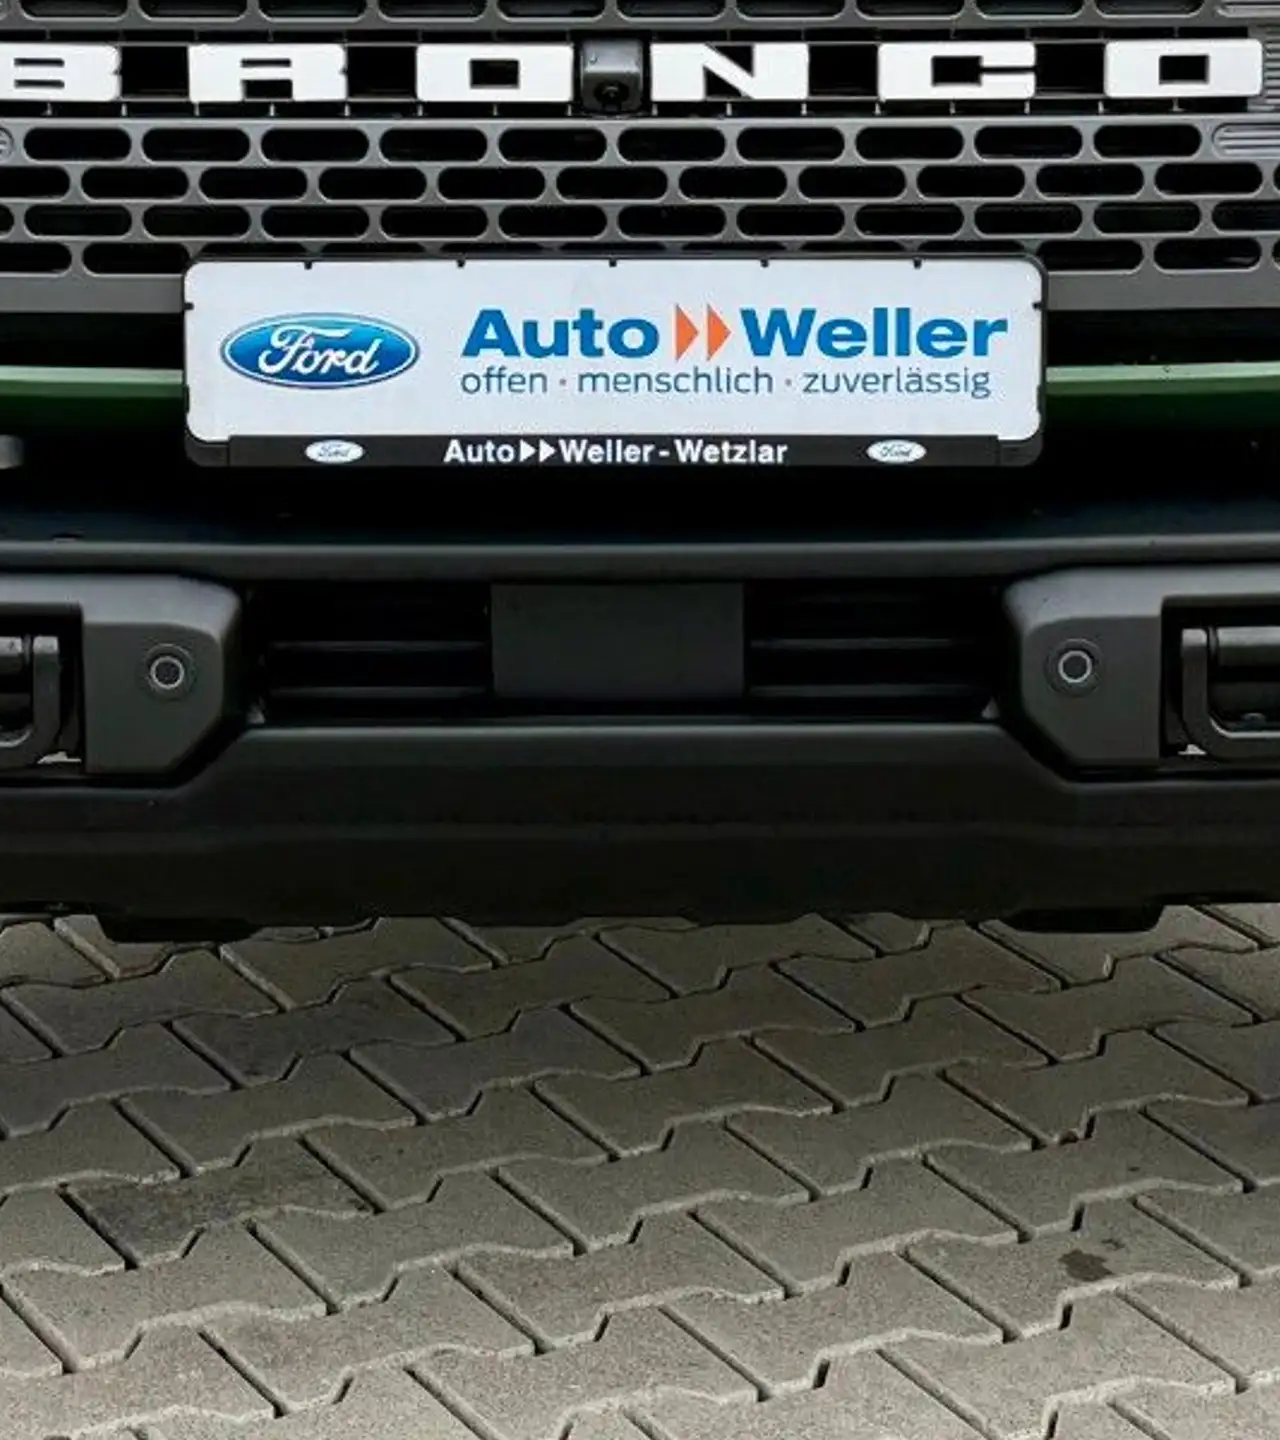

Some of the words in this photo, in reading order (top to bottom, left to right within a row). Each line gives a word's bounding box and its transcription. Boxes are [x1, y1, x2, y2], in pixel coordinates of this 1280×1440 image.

[258, 324, 385, 375] Ford
[461, 308, 660, 358] Auto
[739, 307, 1009, 358] Weller
[461, 366, 548, 394] offen
[578, 366, 773, 394] menschlich
[802, 366, 991, 399] zuverlässig
[443, 439, 515, 463] Auto
[560, 439, 655, 463] Weller
[673, 439, 788, 464] Wetzlar
